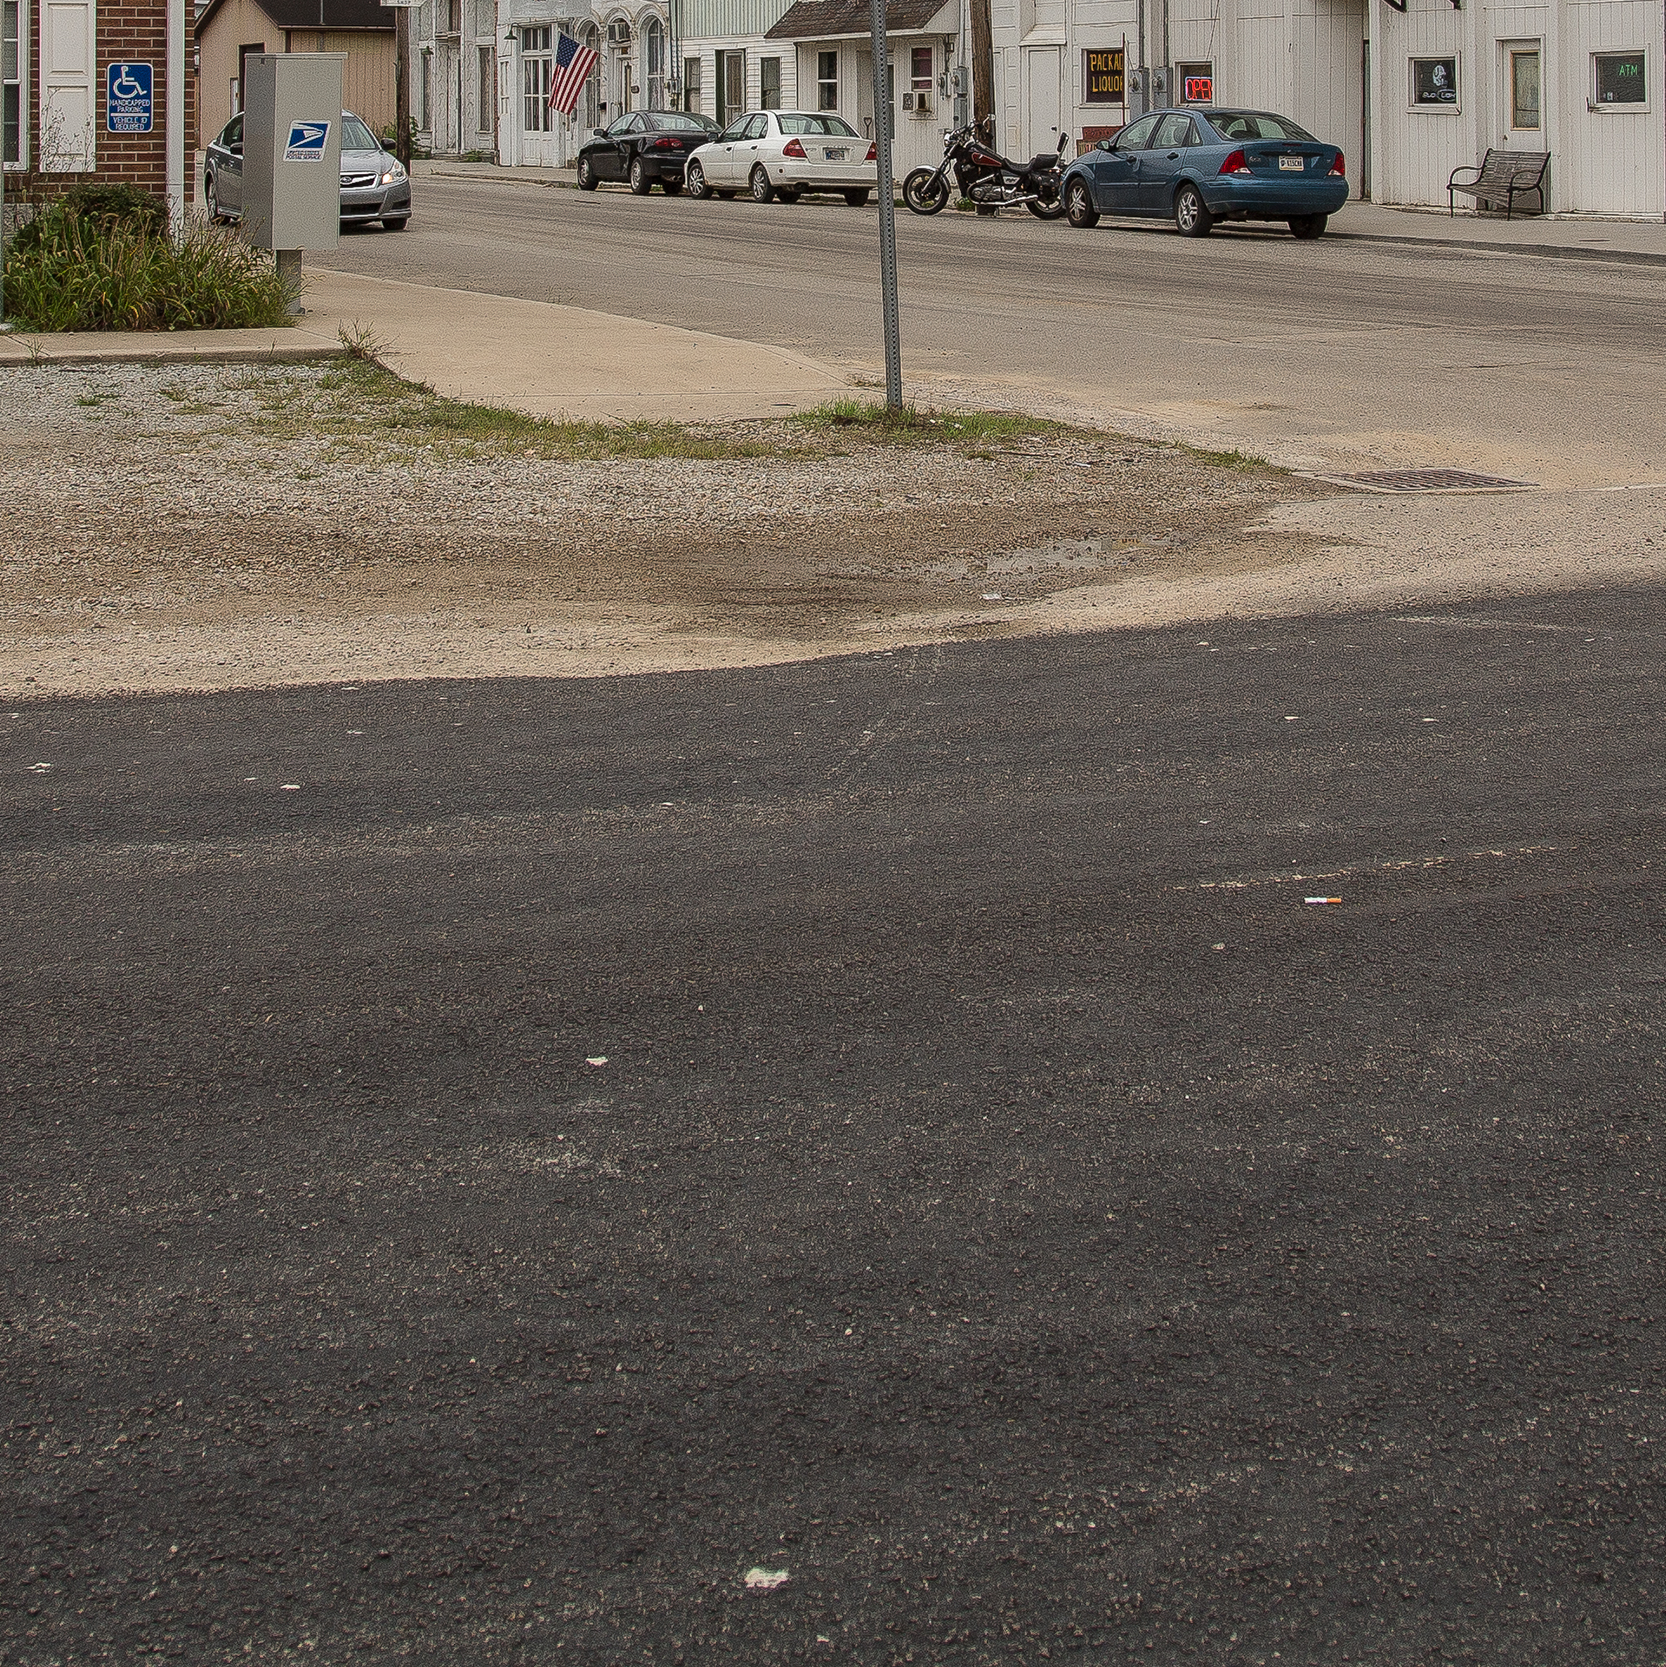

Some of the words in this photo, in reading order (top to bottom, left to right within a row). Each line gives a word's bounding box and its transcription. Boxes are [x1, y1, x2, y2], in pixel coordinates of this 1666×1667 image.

[1090, 53, 1123, 71] PACKAG
[1619, 64, 1638, 76] ATM
[109, 99, 150, 107] HANDICAPPED
